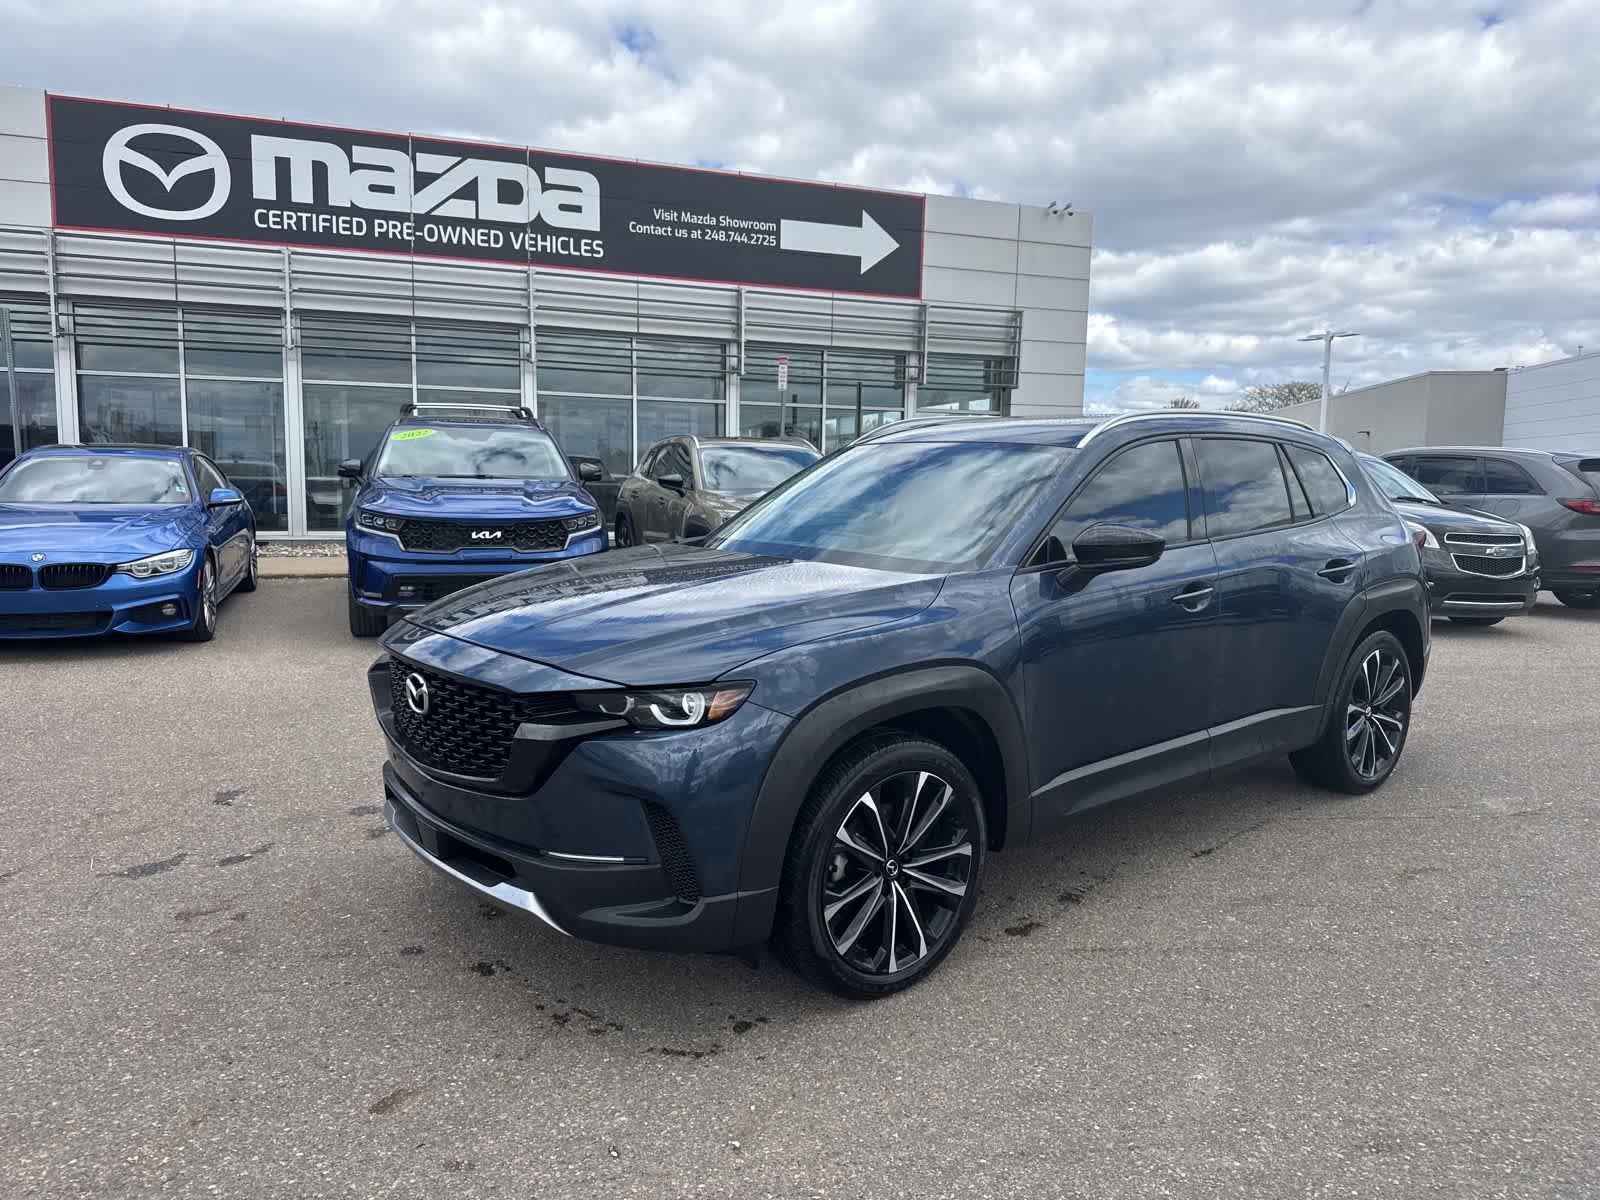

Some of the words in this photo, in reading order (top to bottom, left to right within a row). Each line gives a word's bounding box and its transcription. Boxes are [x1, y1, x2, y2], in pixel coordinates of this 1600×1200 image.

[653, 208, 678, 221] Visit
[681, 211, 716, 225] Mazda
[719, 216, 776, 231] Showroom
[254, 208, 367, 236] CERTIFIED
[374, 219, 503, 248] PRE-OWNED
[510, 231, 604, 258] VEHICLES
[629, 221, 672, 236] Contact
[675, 229, 688, 238] us
[690, 229, 702, 239] at
[704, 229, 776, 246] 248.744.2725
